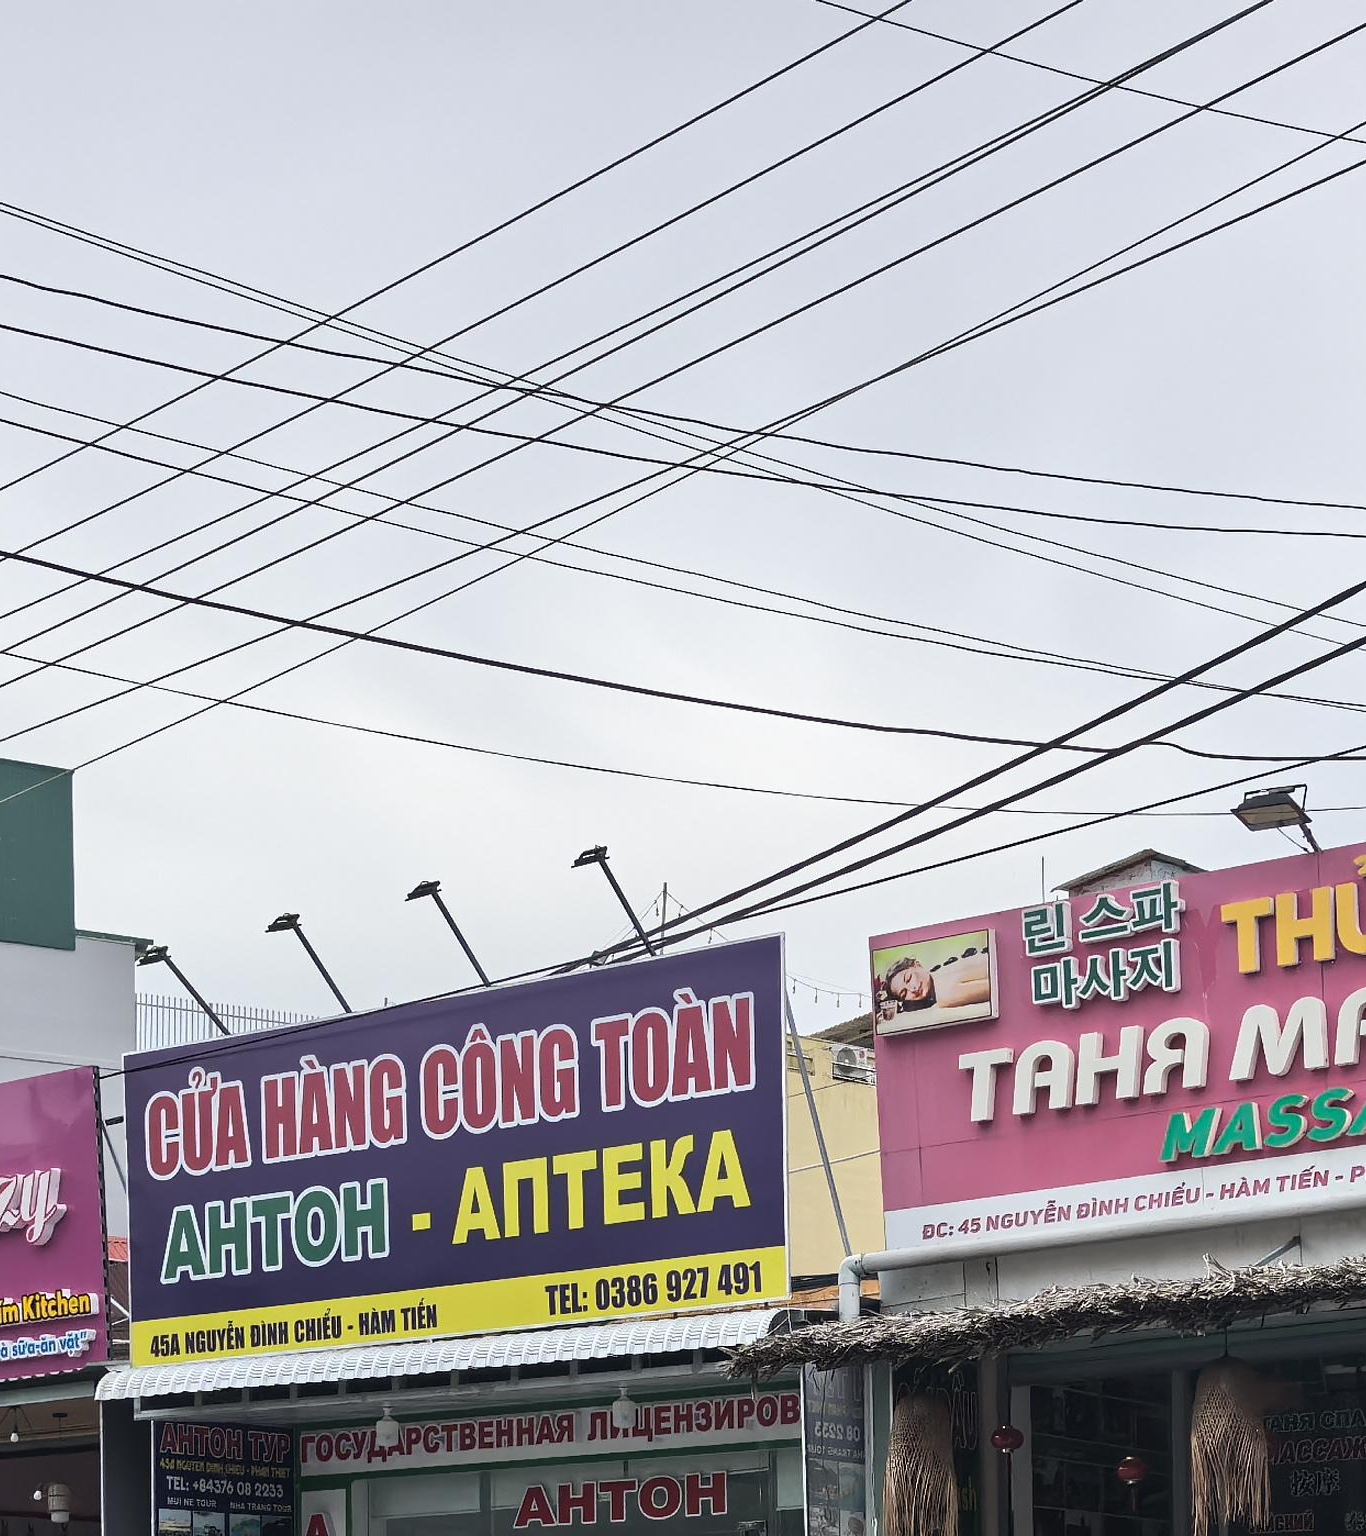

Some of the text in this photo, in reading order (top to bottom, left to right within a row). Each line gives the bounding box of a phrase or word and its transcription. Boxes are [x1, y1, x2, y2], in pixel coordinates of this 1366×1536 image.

[1021, 880, 1185, 956] 린 스파
[1031, 938, 1181, 1010] 마사지
[145, 987, 756, 1180] CỬA HÀNG CÔNG TOÀN
[958, 1017, 1211, 1122] ТАНЯ
[160, 1129, 751, 1284] АНТОН АПТЕКА
[957, 1216, 981, 1235] 45
[986, 1200, 1072, 1232] NGUYỄN
[1077, 1194, 1129, 1222] ĐÌNH
[1135, 1180, 1201, 1213] CHIỂU
[1220, 1172, 1269, 1201] HÀM
[1275, 1165, 1330, 1193] TIẾN
[23, 1290, 91, 1322] Kitchen
[545, 1260, 762, 1316] TEL: 0386 927 491
[151, 1298, 437, 1358] 45A NGUYỄN ĐÌNH CHIỂU HÀM TIẾN
[159, 1422, 291, 1463] АНТОН ТУР
[167, 1476, 283, 1498] TEL: +84376 08 2233
[515, 1471, 728, 1528] АНТОН
